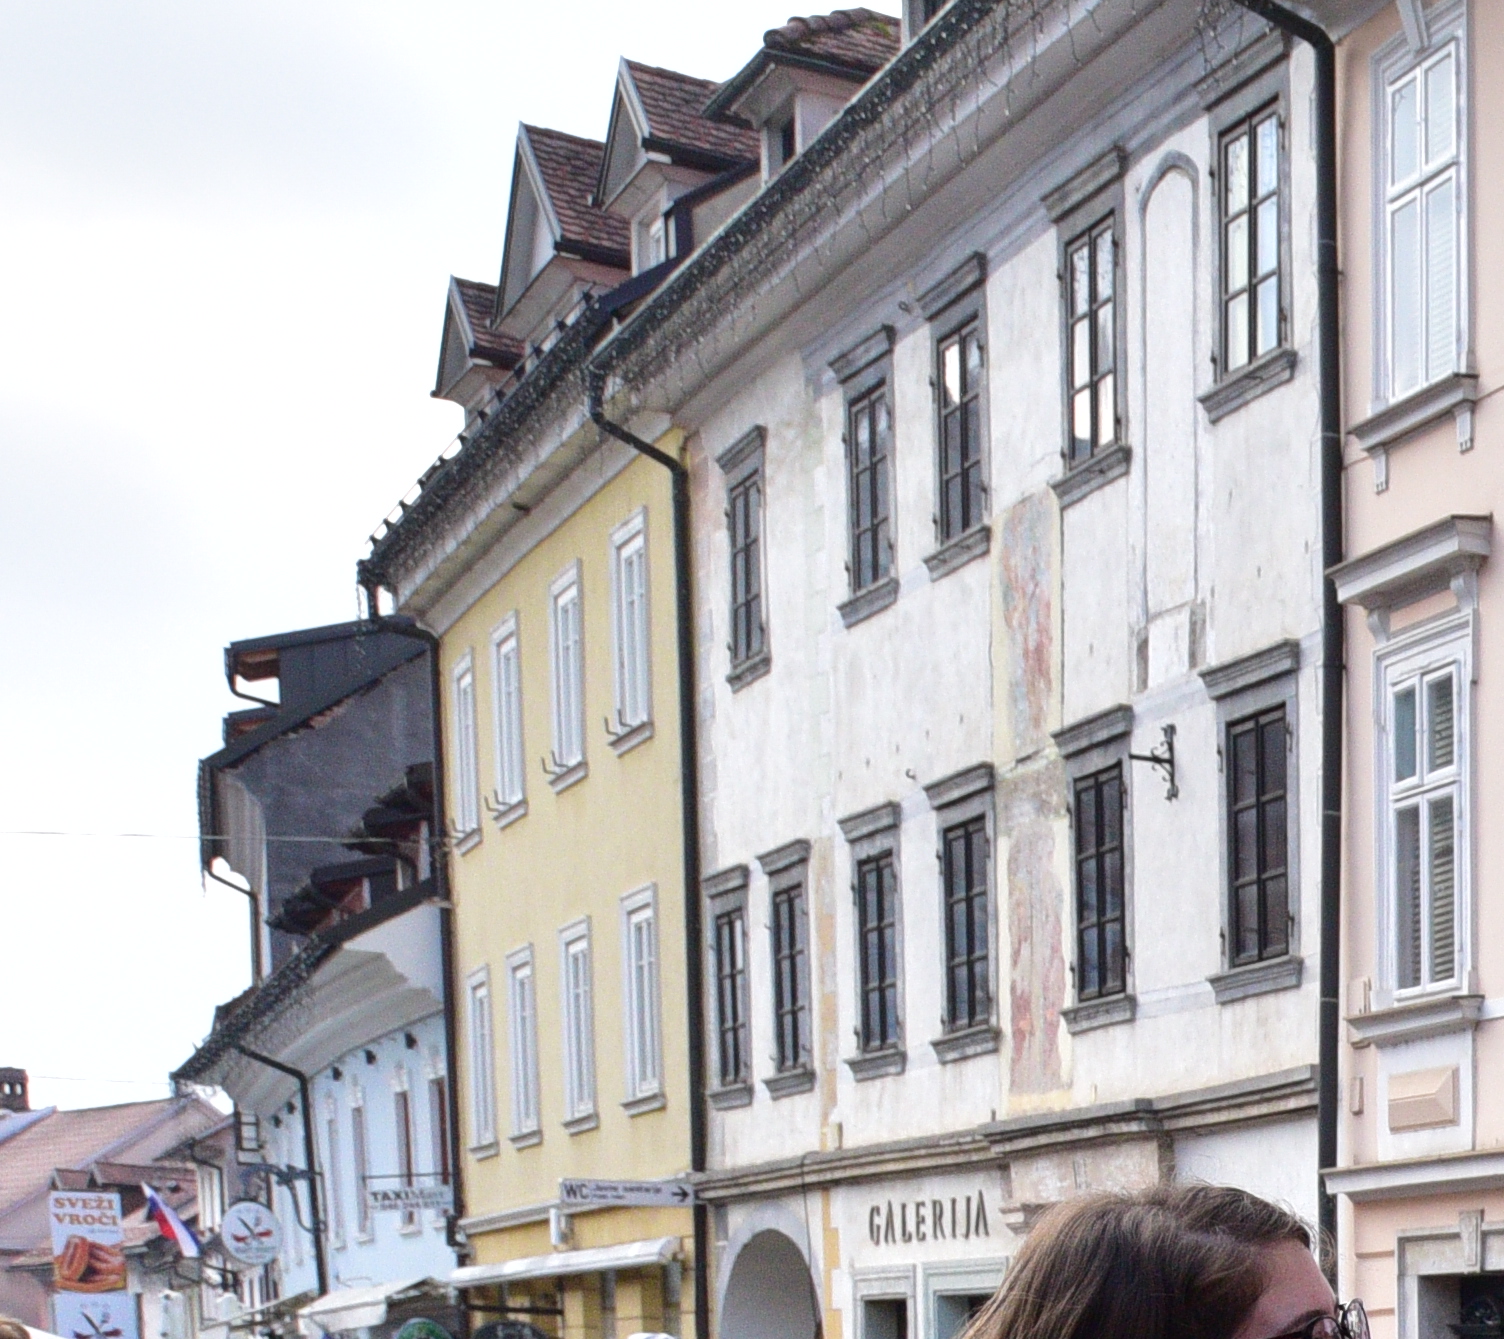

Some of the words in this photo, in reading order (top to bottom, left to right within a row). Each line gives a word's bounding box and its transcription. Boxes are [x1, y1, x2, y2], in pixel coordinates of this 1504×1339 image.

[563, 1183, 588, 1199] WC
[53, 1196, 115, 1209] SVEŽI
[53, 1211, 118, 1226] VROČI
[869, 1189, 990, 1246] GALERIJA
